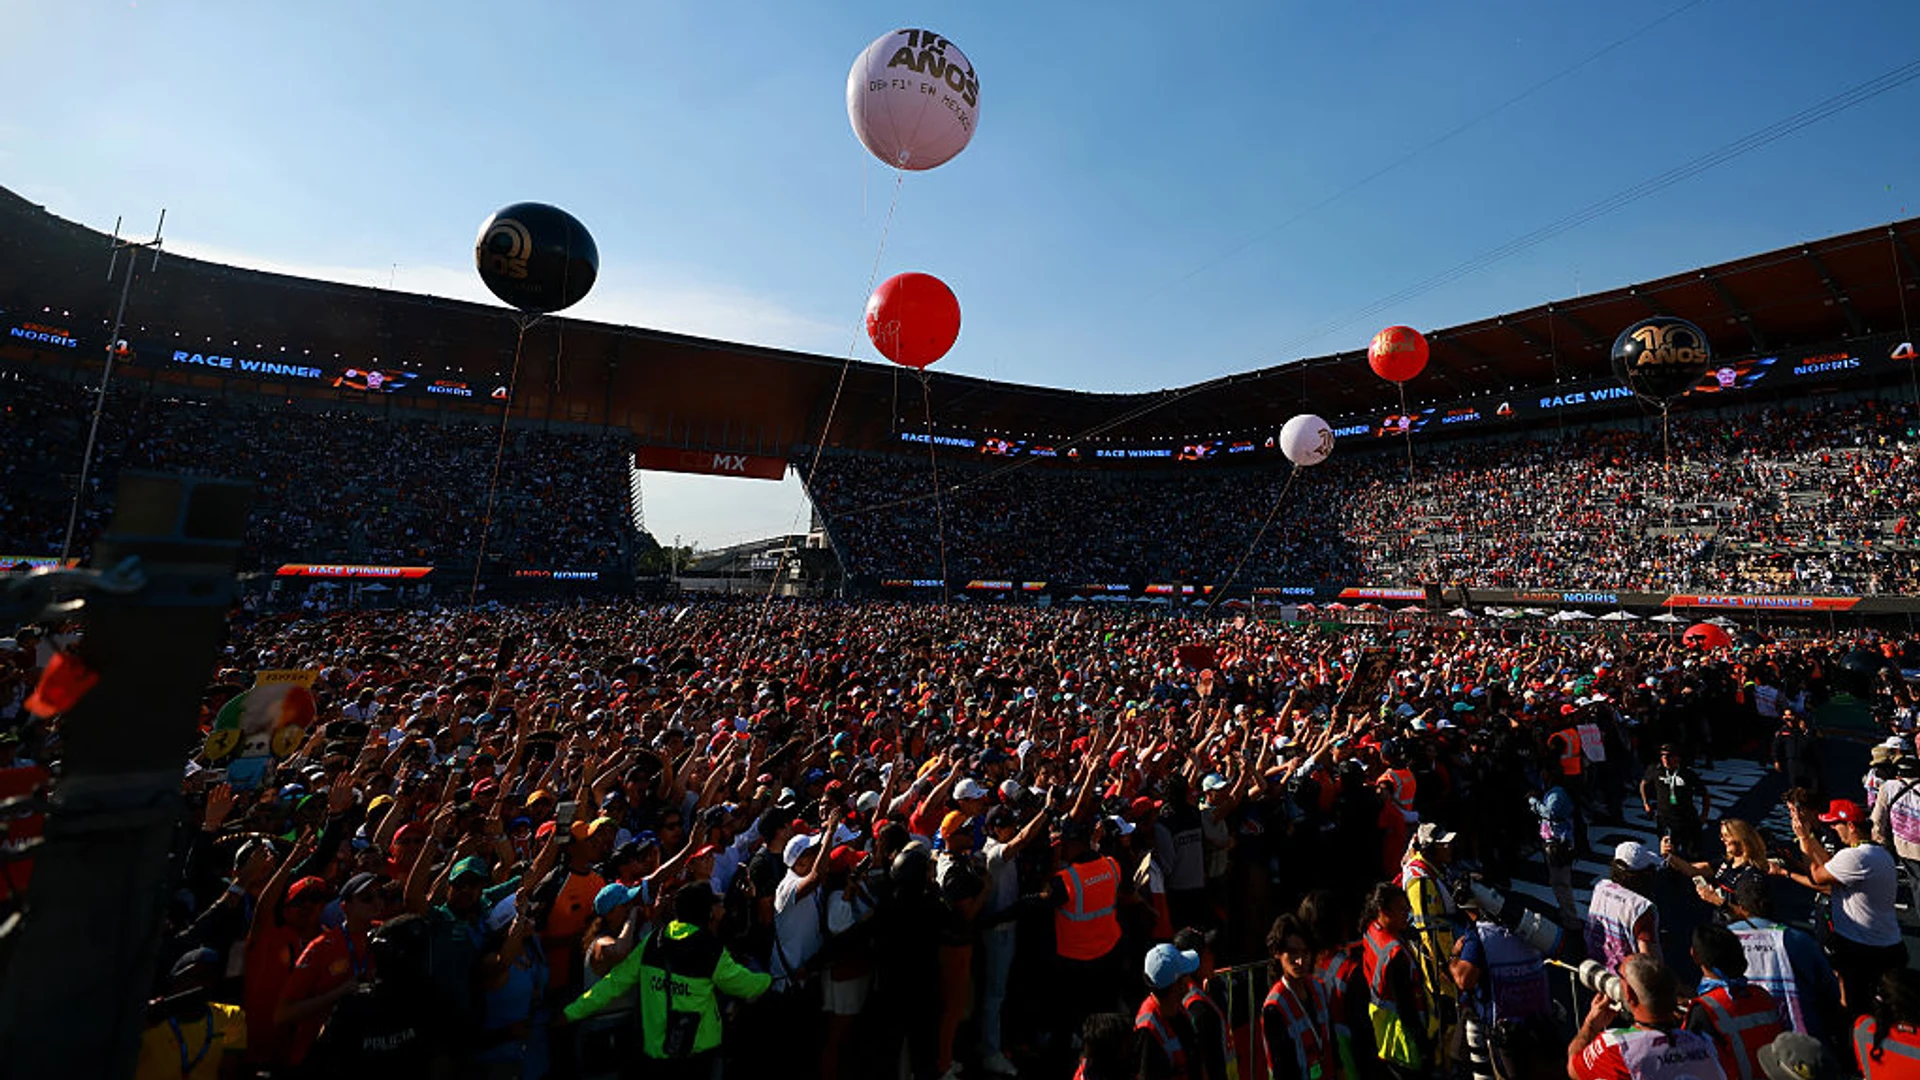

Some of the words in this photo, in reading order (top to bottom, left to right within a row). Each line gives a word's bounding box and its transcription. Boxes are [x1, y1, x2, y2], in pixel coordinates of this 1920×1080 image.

[887, 46, 979, 108] AÑOS
[10, 327, 78, 348] NORRIS
[1636, 345, 1707, 366] AÑOS
[173, 350, 233, 368] RACE
[240, 359, 322, 378] WINNER
[1794, 357, 1861, 375] NORRIS
[1540, 395, 1586, 408] RACE
[1591, 386, 1635, 400] WIN
[1331, 425, 1370, 437] INNER
[901, 433, 931, 443] RACE
[933, 437, 976, 448] WINNER
[308, 566, 344, 575] RACE
[346, 566, 400, 576] WINNER
[553, 570, 599, 581] NORRIS
[1563, 592, 1618, 604] NORRIS
[1698, 595, 1738, 607] RACE
[1741, 597, 1814, 608] WINNER
